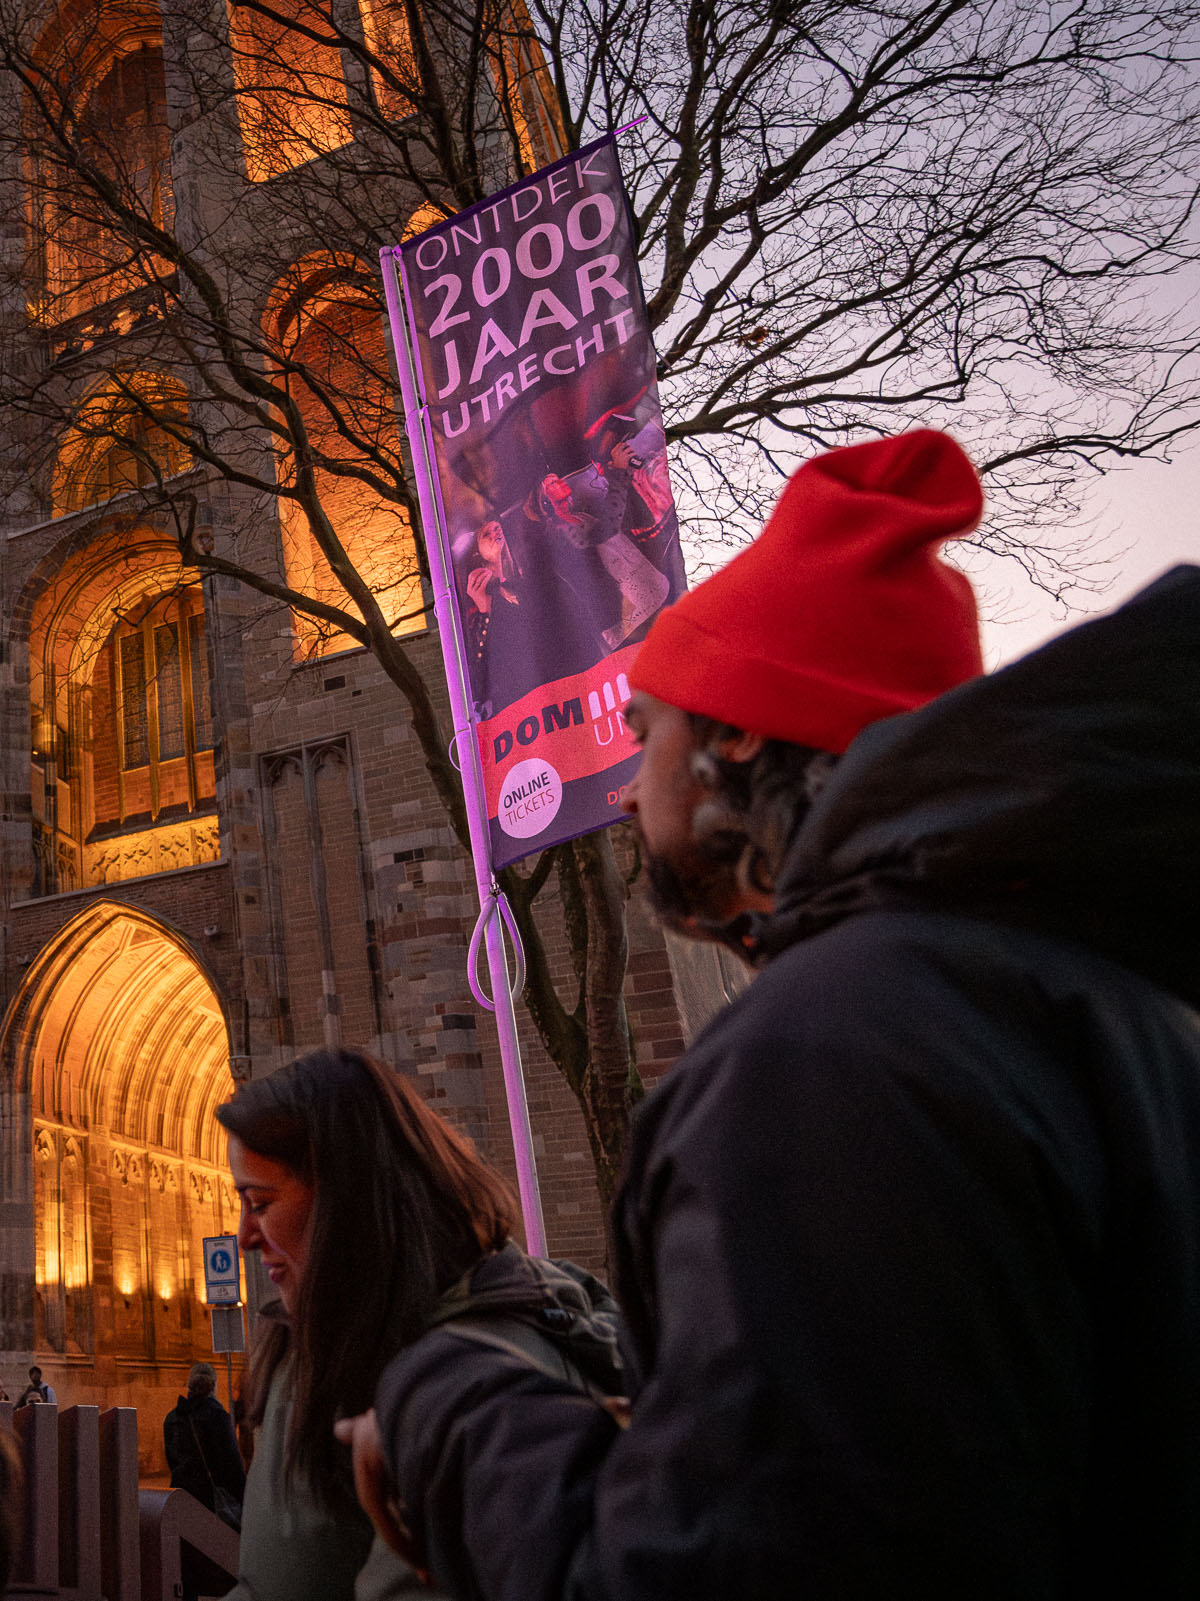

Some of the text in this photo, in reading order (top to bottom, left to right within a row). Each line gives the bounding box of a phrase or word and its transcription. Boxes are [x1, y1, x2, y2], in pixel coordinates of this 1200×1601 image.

[415, 148, 607, 271] ONTDEK
[423, 192, 616, 339] 2000
[438, 253, 630, 400] JAAR
[441, 307, 634, 439] UTRECHT
[493, 697, 585, 764] DOM
[503, 771, 551, 809] ONLINE
[505, 788, 555, 825] TICKETS
